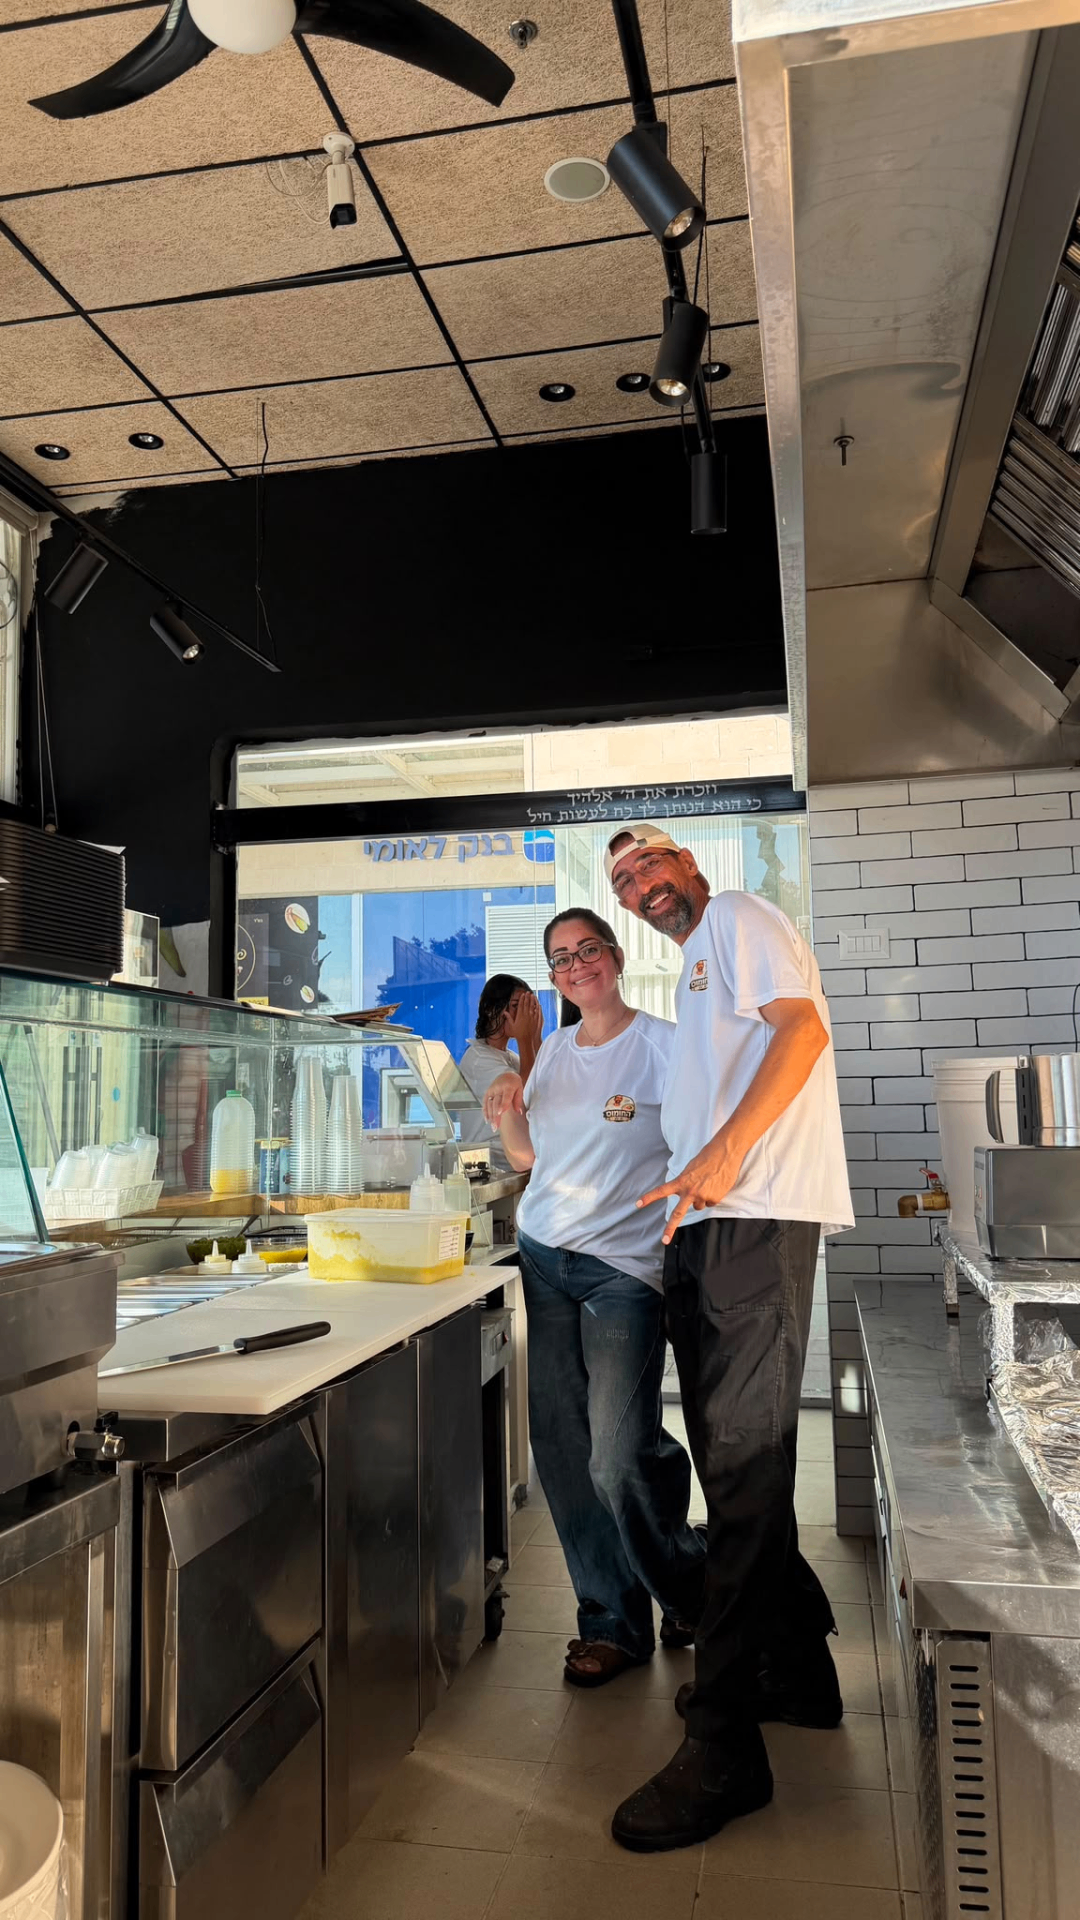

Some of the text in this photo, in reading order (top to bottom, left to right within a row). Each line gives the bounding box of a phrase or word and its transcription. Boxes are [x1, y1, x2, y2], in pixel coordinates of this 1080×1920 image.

[567, 788, 613, 807] אלהיך
[642, 787, 667, 800] את
[673, 784, 718, 799] וזכרת
[526, 798, 762, 823] כי הוא הנותן לך כח לעשות חיל
[363, 833, 515, 863] בנק לאומי
